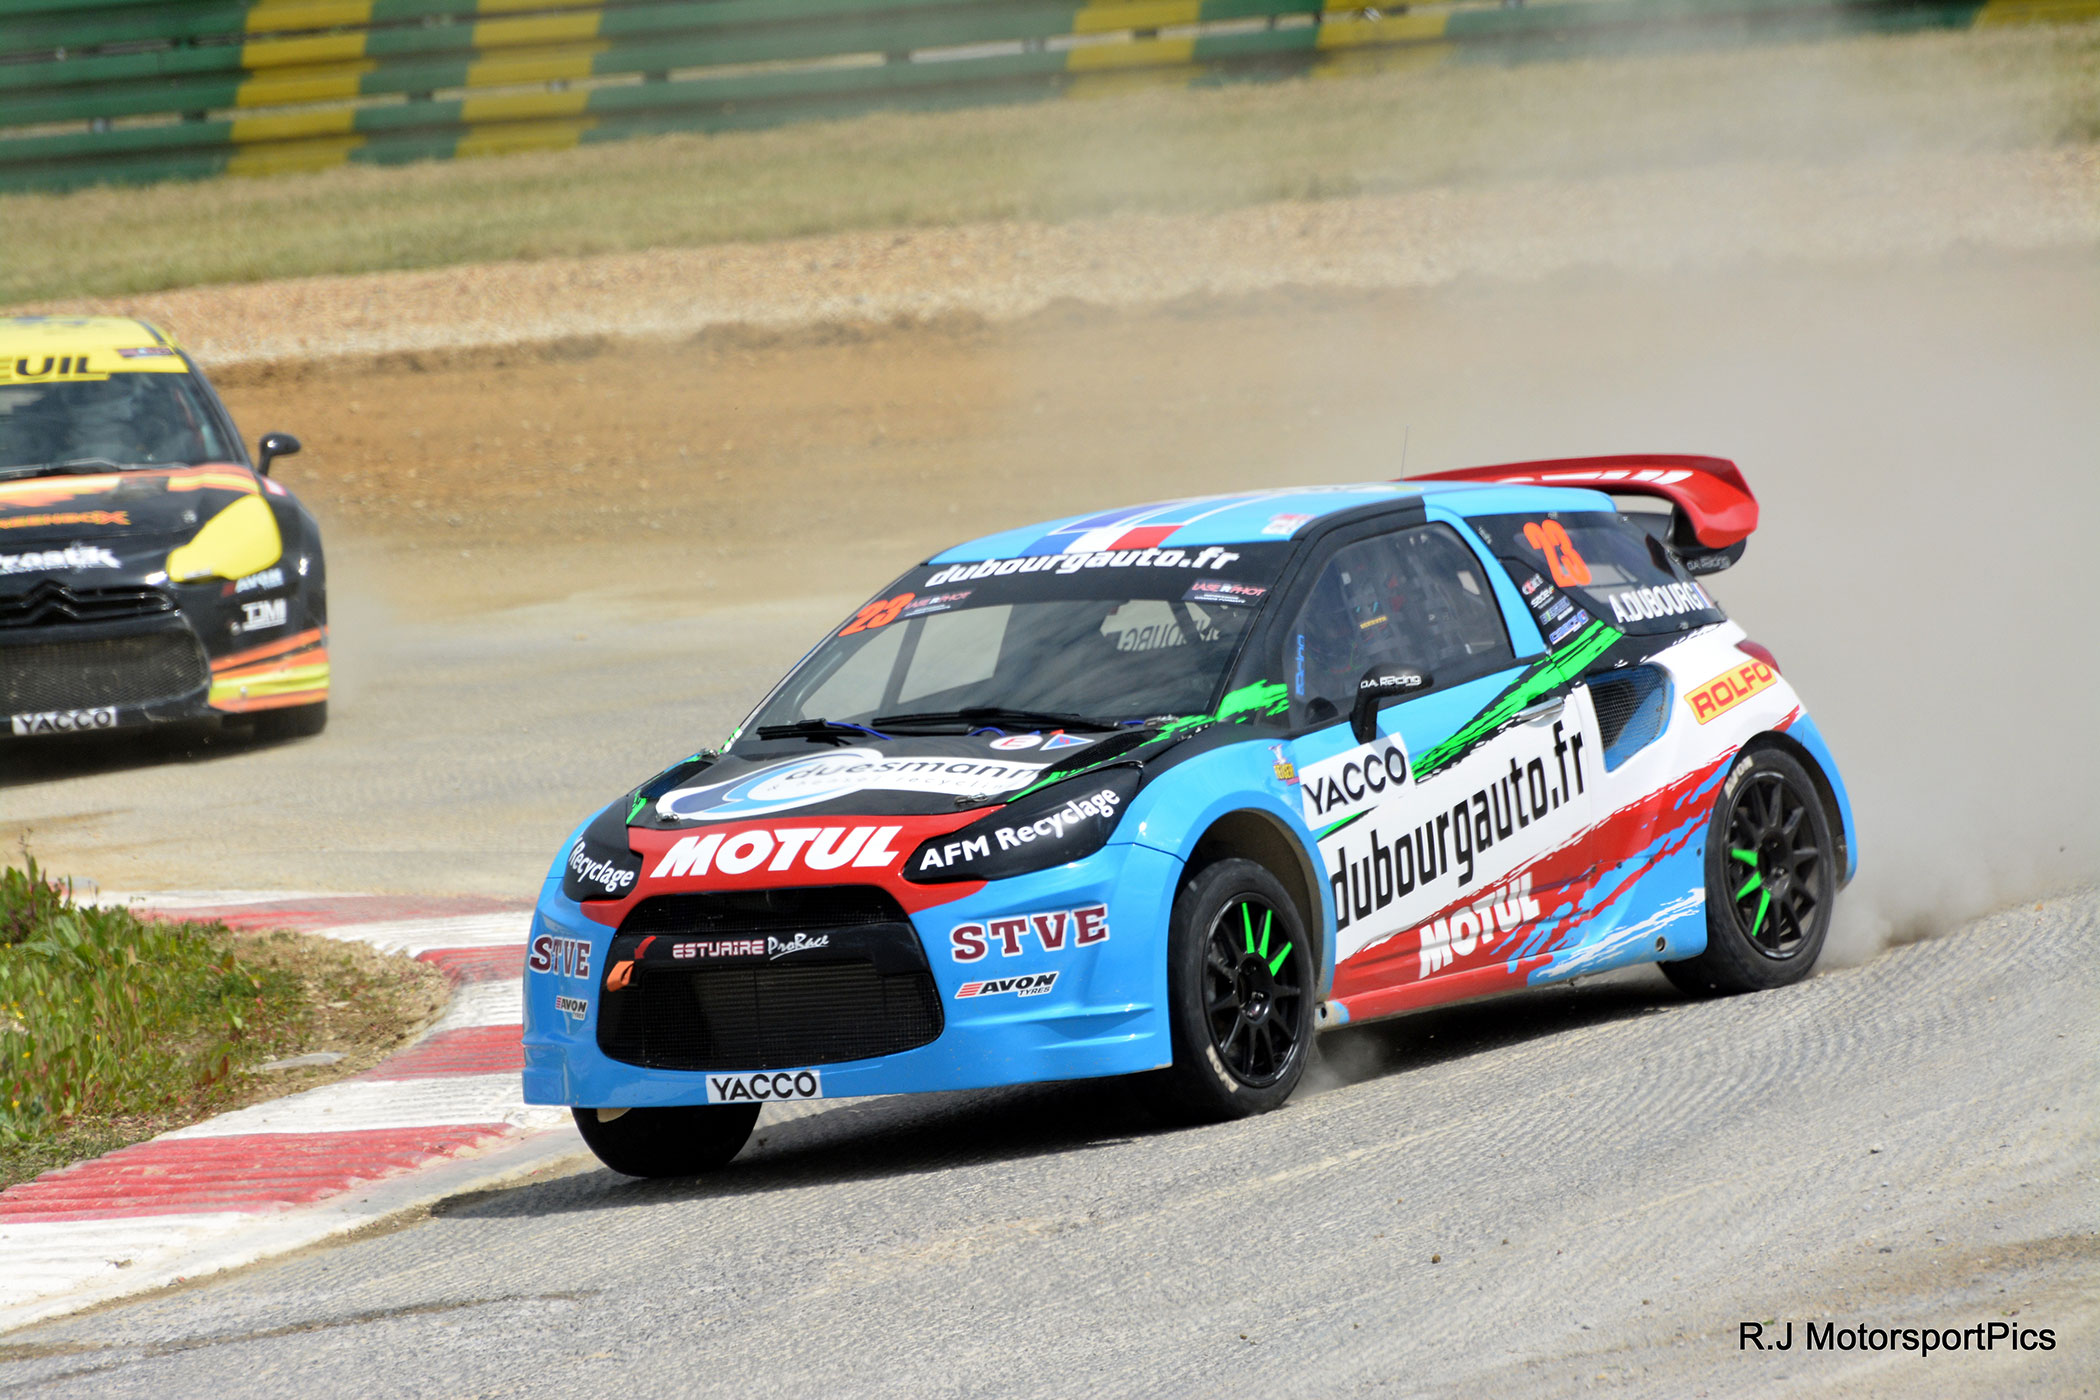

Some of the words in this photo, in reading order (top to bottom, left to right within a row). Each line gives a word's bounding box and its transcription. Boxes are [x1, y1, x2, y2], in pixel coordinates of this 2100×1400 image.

[924, 546, 1240, 588] dubourgauto.fr
[1523, 519, 1593, 588] 23
[838, 592, 915, 637] 23
[1608, 582, 1704, 623] A.DUBOURG
[1691, 661, 1773, 719] ROLFO
[20, 711, 112, 734] YACCO
[1300, 745, 1407, 816] YACCO
[919, 835, 991, 871] AFM
[994, 788, 1121, 852] Recyclage
[1330, 720, 1585, 932] dubourgauto.fr
[569, 841, 635, 892] Recyclage
[650, 826, 902, 878] MOTUL
[951, 905, 1109, 962] STVE
[1418, 872, 1541, 980] MOTUL
[529, 934, 592, 980] STVE
[561, 998, 588, 1012] AVON
[979, 973, 1057, 995] AVON
[1019, 986, 1051, 996] TYRES
[711, 1071, 818, 1101] YACCO
